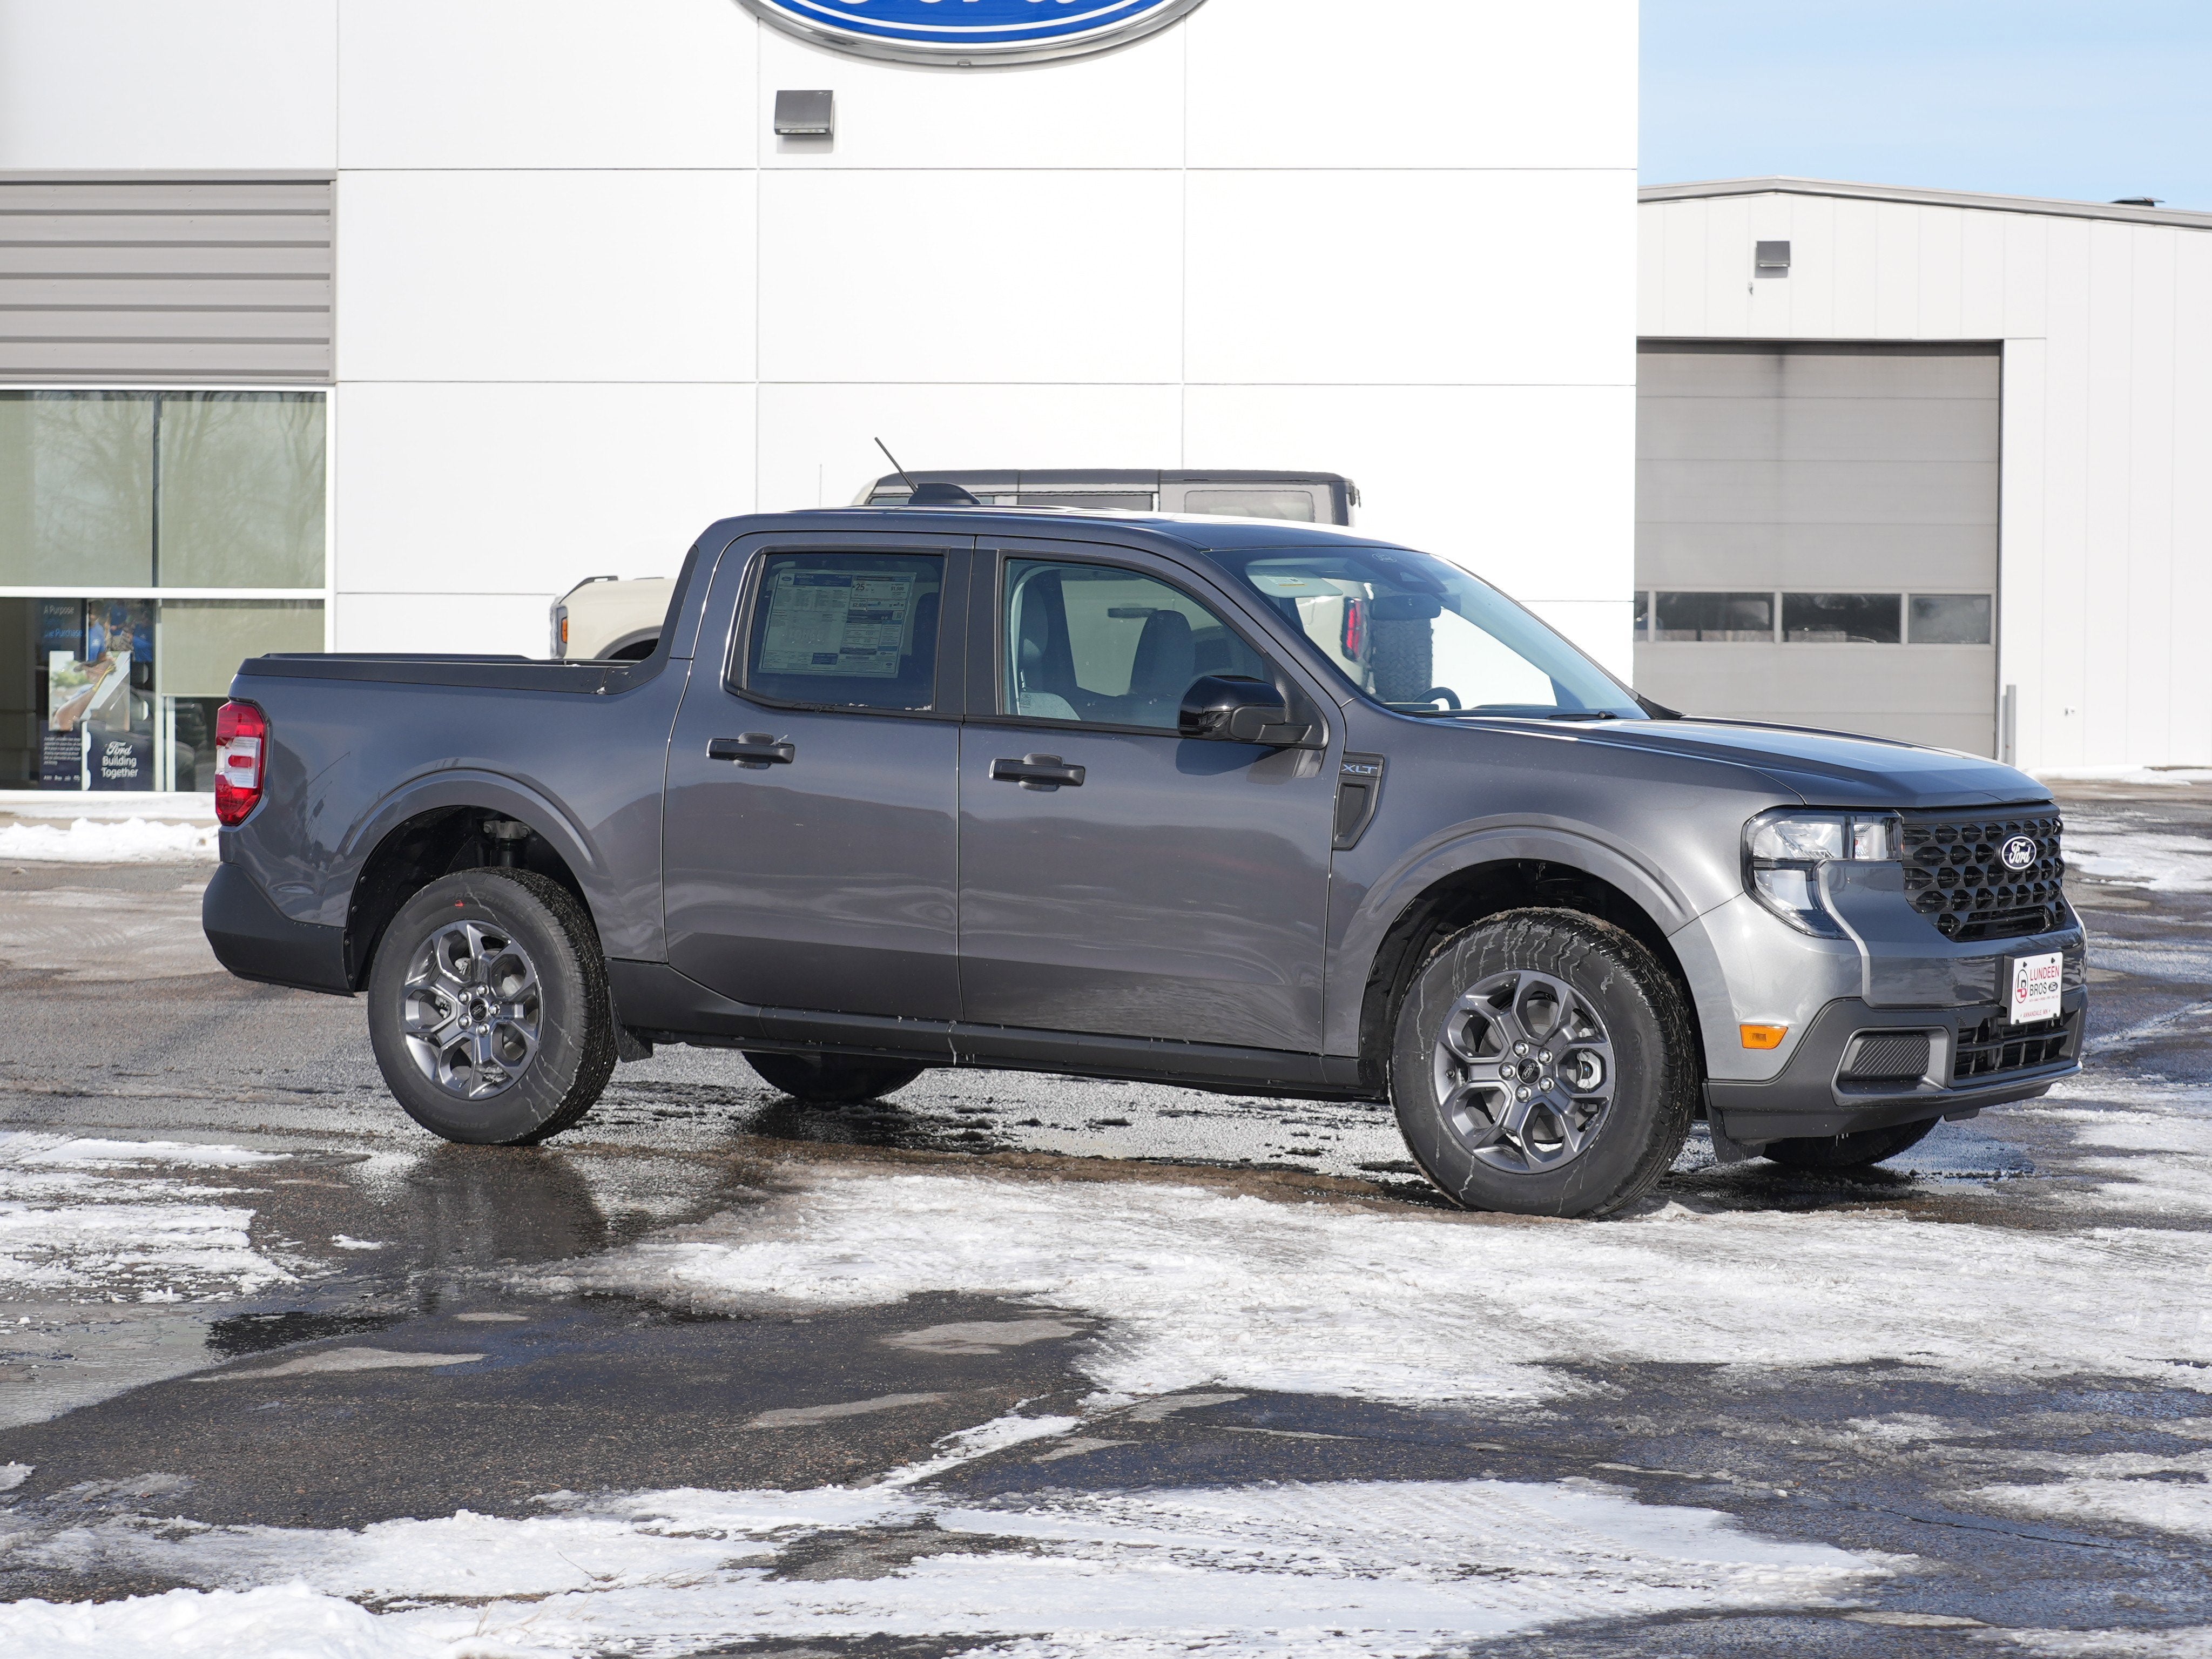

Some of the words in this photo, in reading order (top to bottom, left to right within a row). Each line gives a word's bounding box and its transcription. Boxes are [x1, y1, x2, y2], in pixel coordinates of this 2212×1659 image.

[49, 605, 75, 616] Purpose
[106, 741, 133, 756] Ford
[102, 756, 137, 768] Building
[101, 767, 139, 780] Together
[1341, 764, 1378, 774] XLT
[2009, 841, 2031, 864] Ford
[2030, 965, 2060, 981] LUNDEEN
[2029, 982, 2047, 996] BROS
